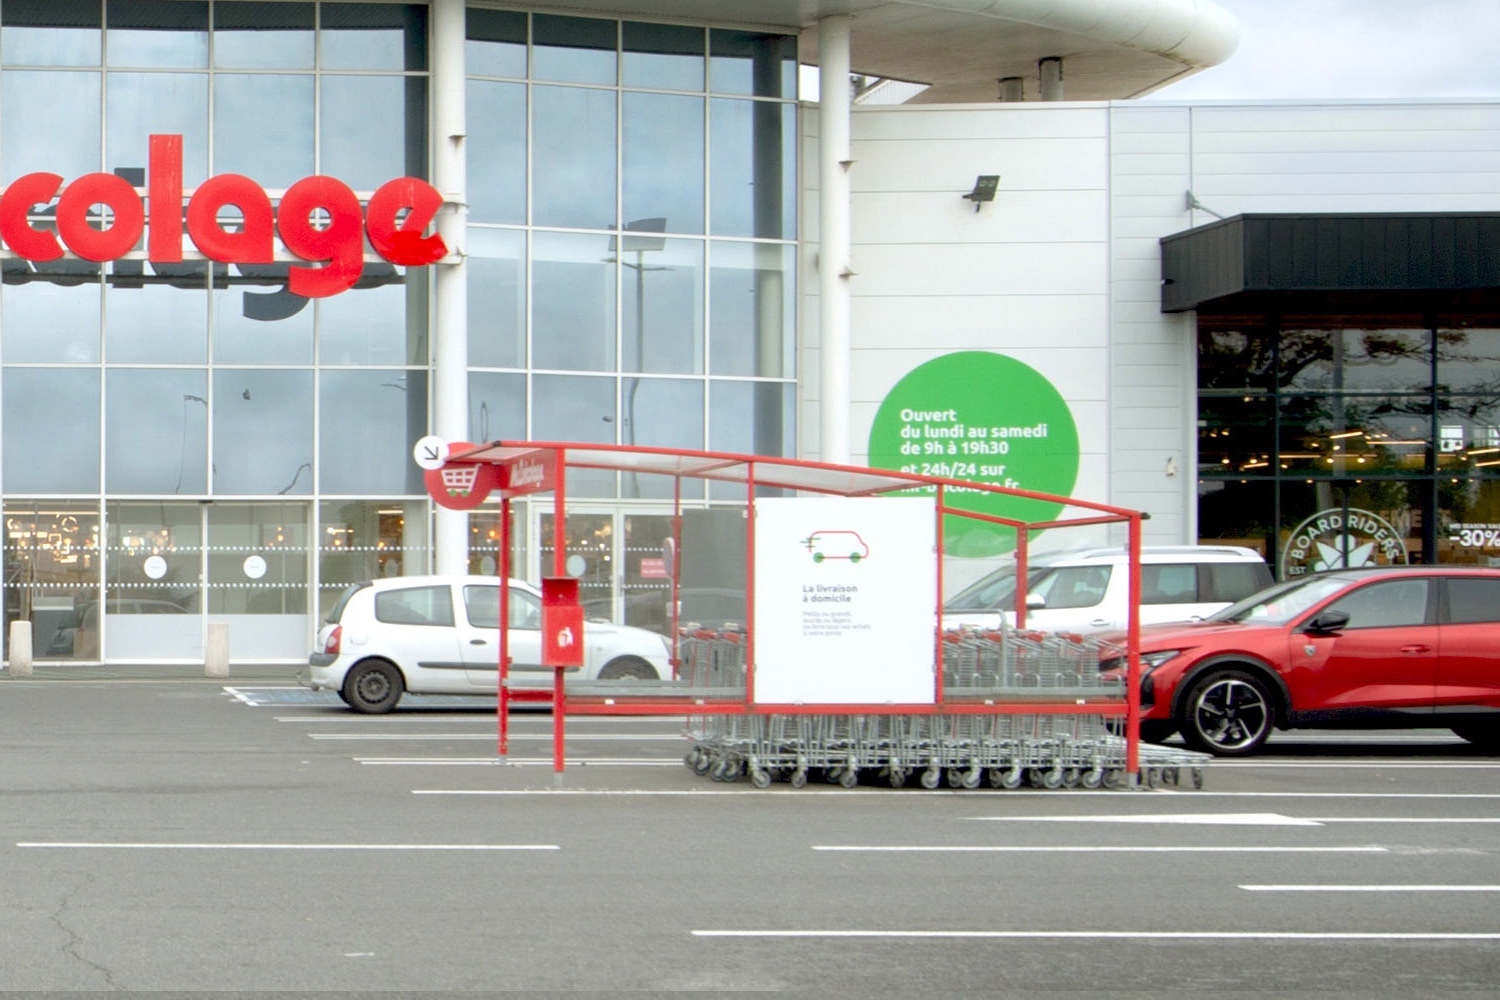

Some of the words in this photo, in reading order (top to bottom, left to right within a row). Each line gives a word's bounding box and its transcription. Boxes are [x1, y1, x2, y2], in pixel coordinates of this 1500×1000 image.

[900, 408, 957, 422] Ouvert
[900, 424, 921, 438] du
[924, 424, 964, 438] lundi
[967, 427, 987, 438] au
[991, 424, 1048, 438] samedi
[900, 441, 920, 455] de
[924, 441, 943, 455] 9h
[947, 441, 958, 455] à
[961, 441, 1009, 455] 19h30
[900, 463, 917, 474] et
[921, 462, 977, 479] 24h/24
[980, 465, 1006, 476] sur
[1291, 515, 1342, 560] BOARD
[1348, 515, 1399, 559] RIDERS
[1449, 530, 1500, 547] -30%
[802, 584, 814, 593] La
[816, 584, 858, 593] livraison
[810, 594, 852, 602] domicile
